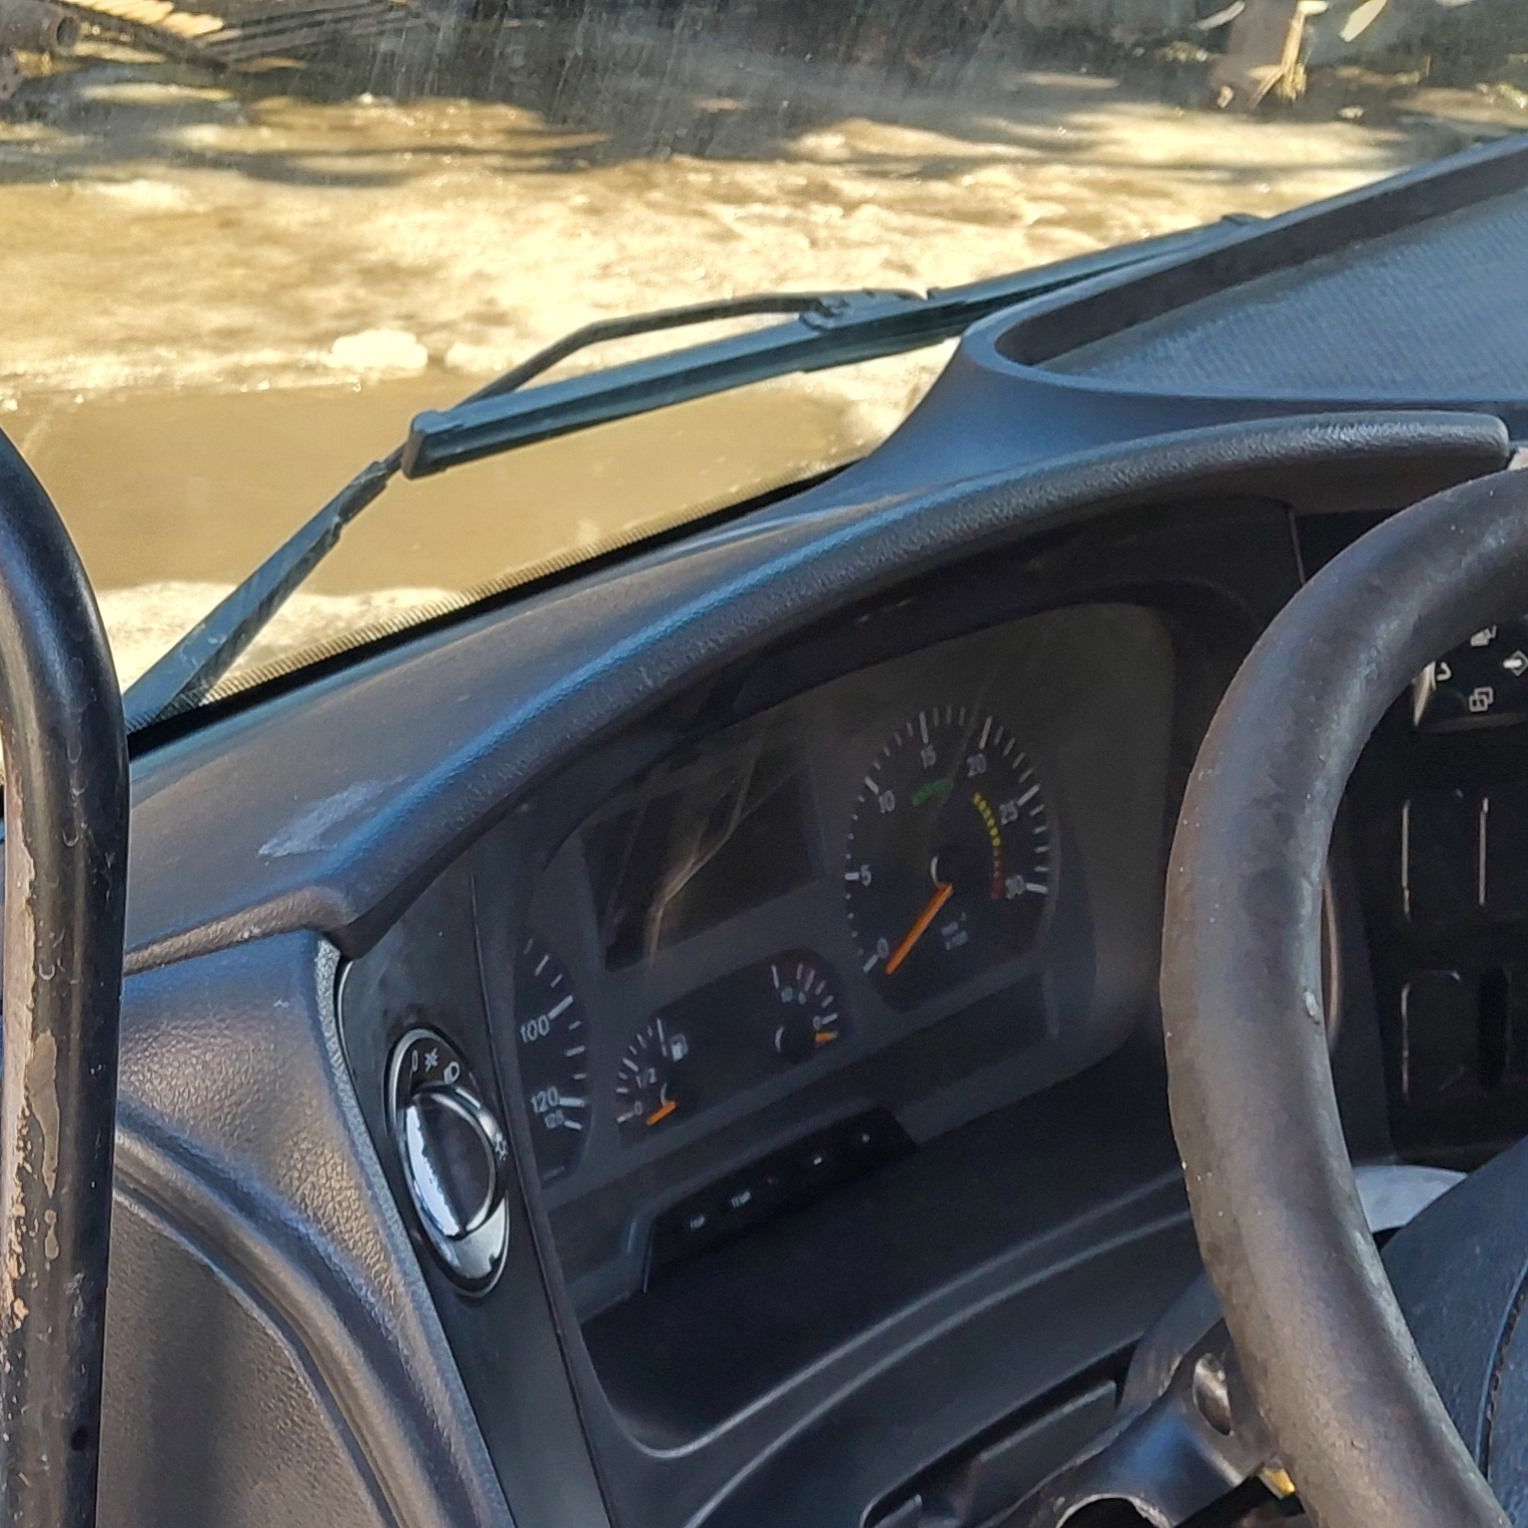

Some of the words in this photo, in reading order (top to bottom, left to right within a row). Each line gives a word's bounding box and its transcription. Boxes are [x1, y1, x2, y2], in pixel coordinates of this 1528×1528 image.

[967, 753, 987, 777] 20
[879, 790, 896, 814] 10
[999, 800, 1019, 825] 25
[861, 864, 872, 887] 5
[877, 937, 889, 959] 0
[520, 1014, 550, 1043] 100
[532, 1085, 559, 1113] 120
[634, 1101, 643, 1116] 0
